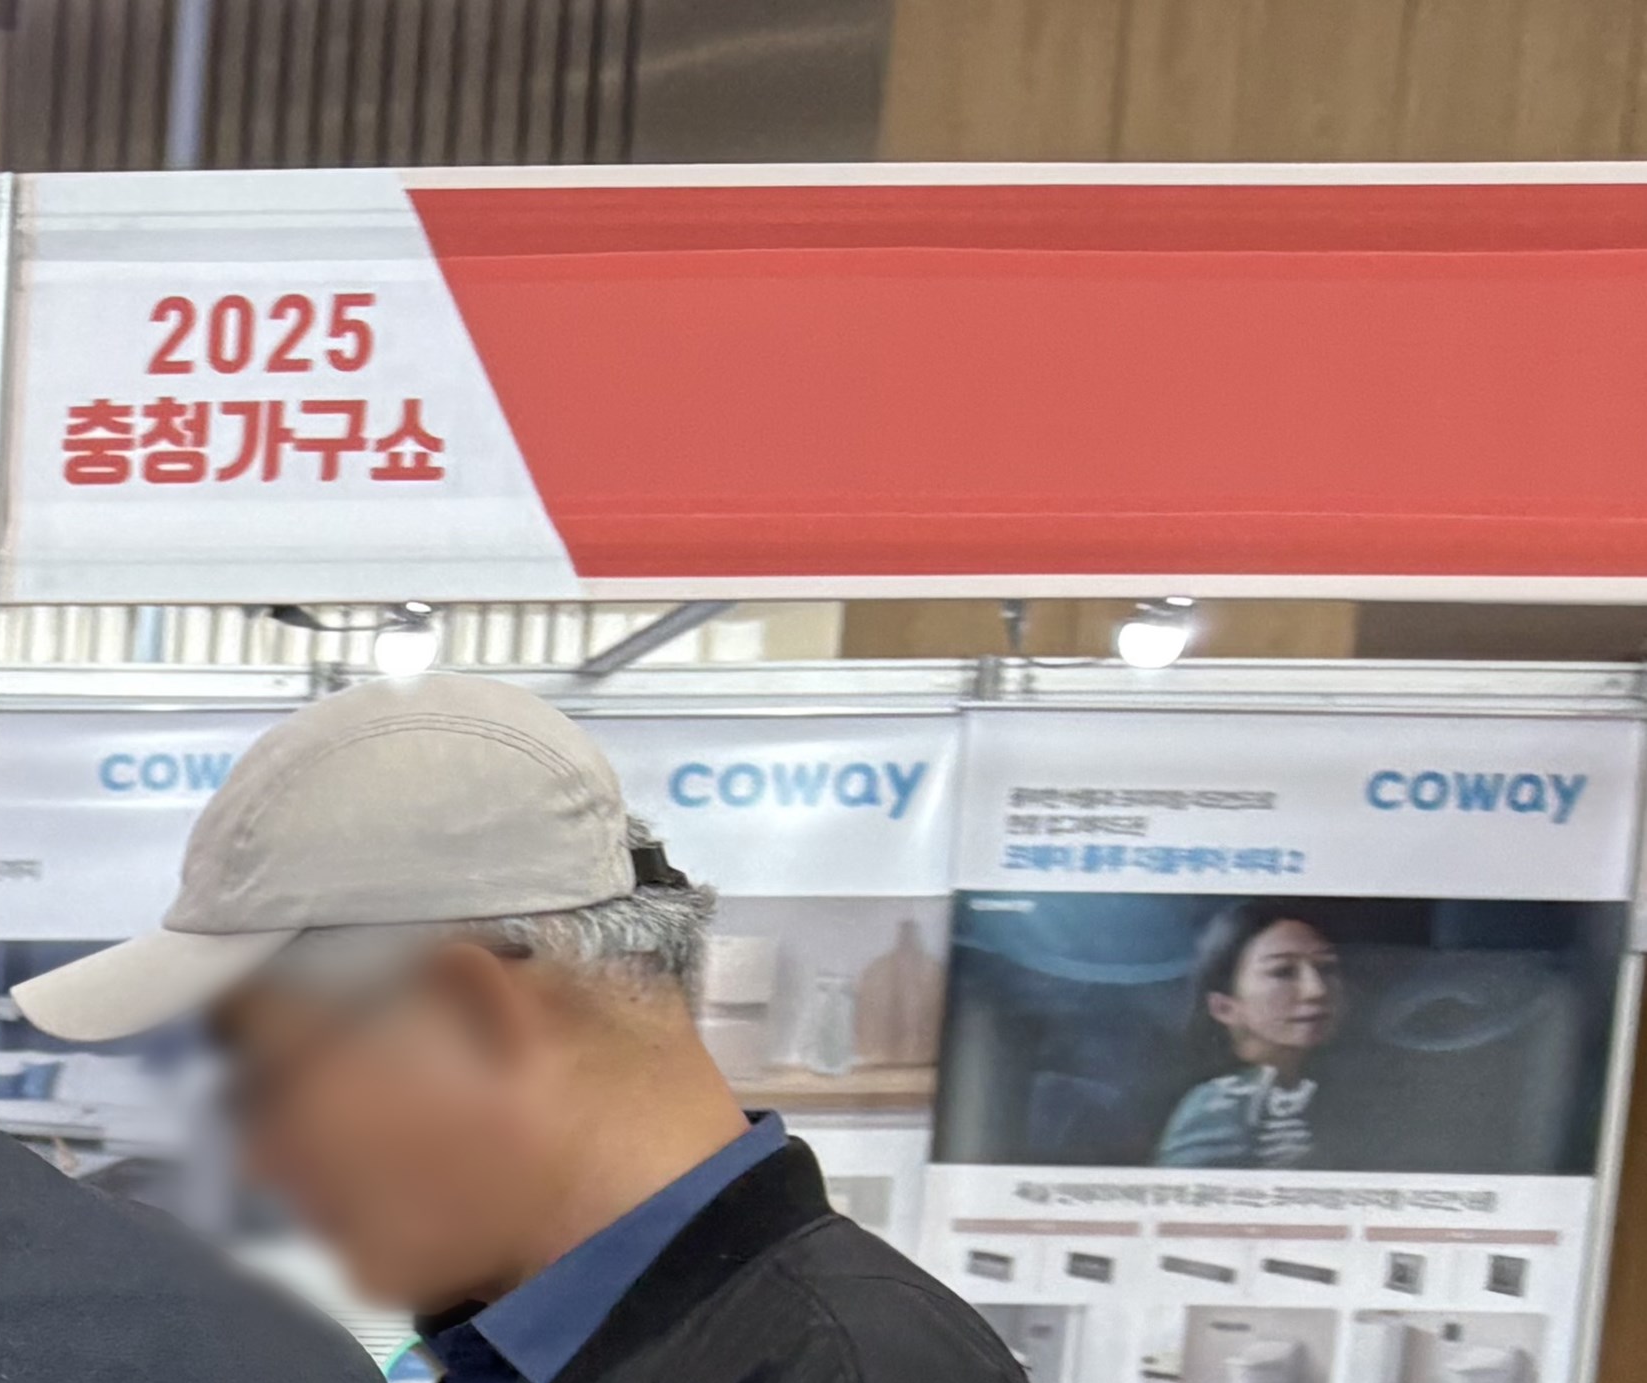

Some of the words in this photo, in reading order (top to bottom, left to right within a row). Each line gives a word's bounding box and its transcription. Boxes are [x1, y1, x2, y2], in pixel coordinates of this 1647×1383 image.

[148, 294, 376, 375] 2025
[63, 398, 445, 486] 충청가구쇼
[98, 753, 236, 795] cow
[668, 762, 931, 822] coway
[1366, 770, 1587, 823] coway
